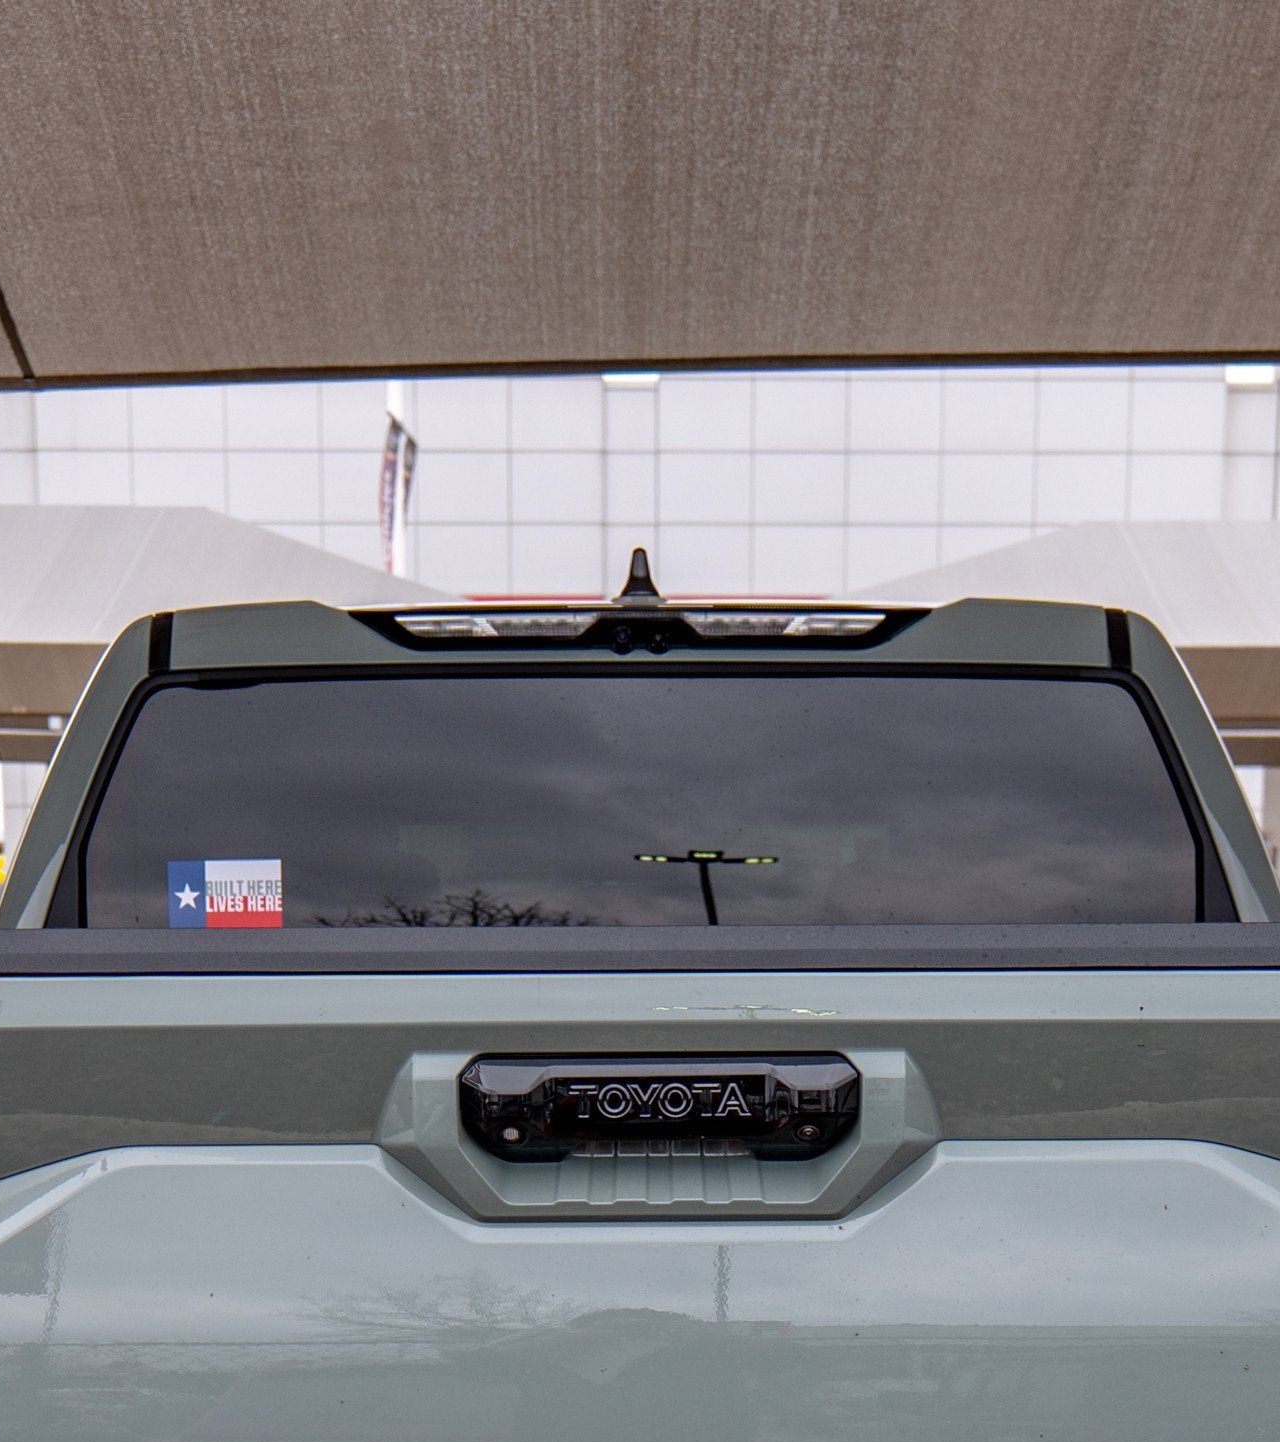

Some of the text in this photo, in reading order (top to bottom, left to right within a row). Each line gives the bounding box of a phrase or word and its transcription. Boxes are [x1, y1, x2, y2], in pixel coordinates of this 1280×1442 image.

[205, 880, 282, 896] BUILT HERE
[205, 895, 282, 912] LIVES HERE
[567, 1082, 752, 1119] TOYOTA
